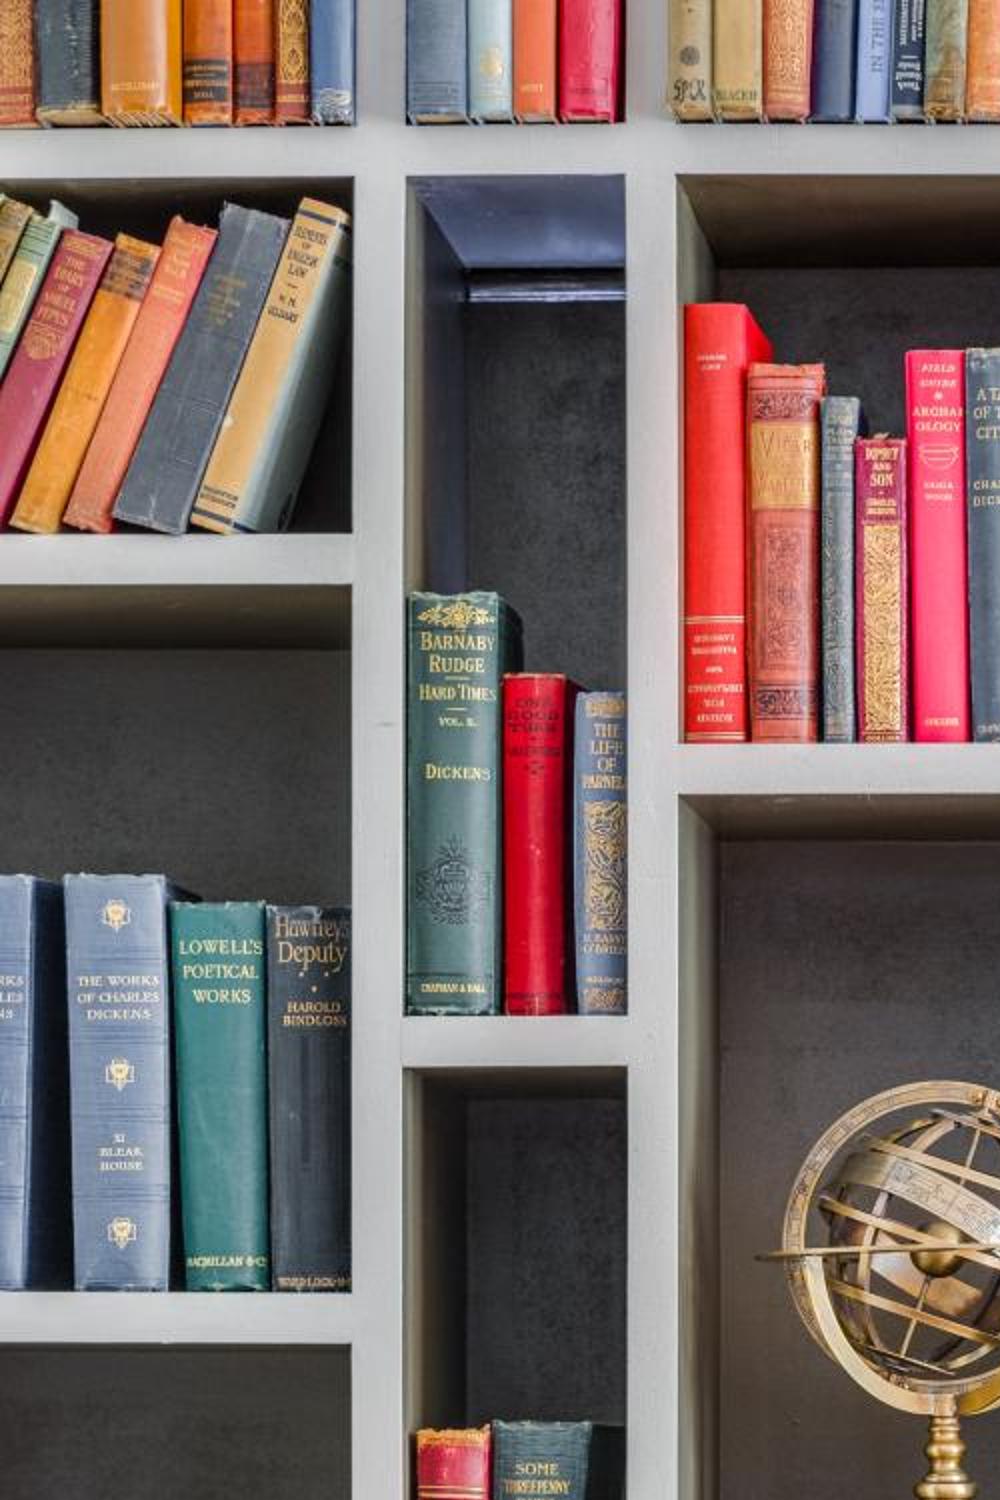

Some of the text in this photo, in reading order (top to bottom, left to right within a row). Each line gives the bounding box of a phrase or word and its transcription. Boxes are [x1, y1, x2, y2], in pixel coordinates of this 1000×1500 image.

[977, 389, 988, 400] A
[974, 408, 990, 419] OF
[915, 422, 961, 432] OLOGY
[869, 474, 894, 487] SON
[421, 631, 495, 652] BARNABY
[429, 654, 485, 673] RUDGE
[419, 684, 496, 701] HARD TIMES
[593, 723, 619, 738] THE
[590, 741, 624, 755] LIFE
[597, 757, 616, 772] OF
[425, 763, 491, 781] DICKENS
[179, 939, 263, 956] LOWELL'S
[277, 941, 347, 971] Deputy
[183, 964, 259, 980] POETICAL
[77, 975, 160, 987] THE WORKS
[77, 991, 161, 1003] OF CHARLES
[192, 989, 251, 1003] WORKS
[287, 1001, 341, 1013] HAROLD
[87, 1009, 152, 1021] DICKENS
[100, 1147, 144, 1157] BLEAK
[100, 1161, 144, 1171] HOUSE
[515, 1463, 559, 1476] SOME
